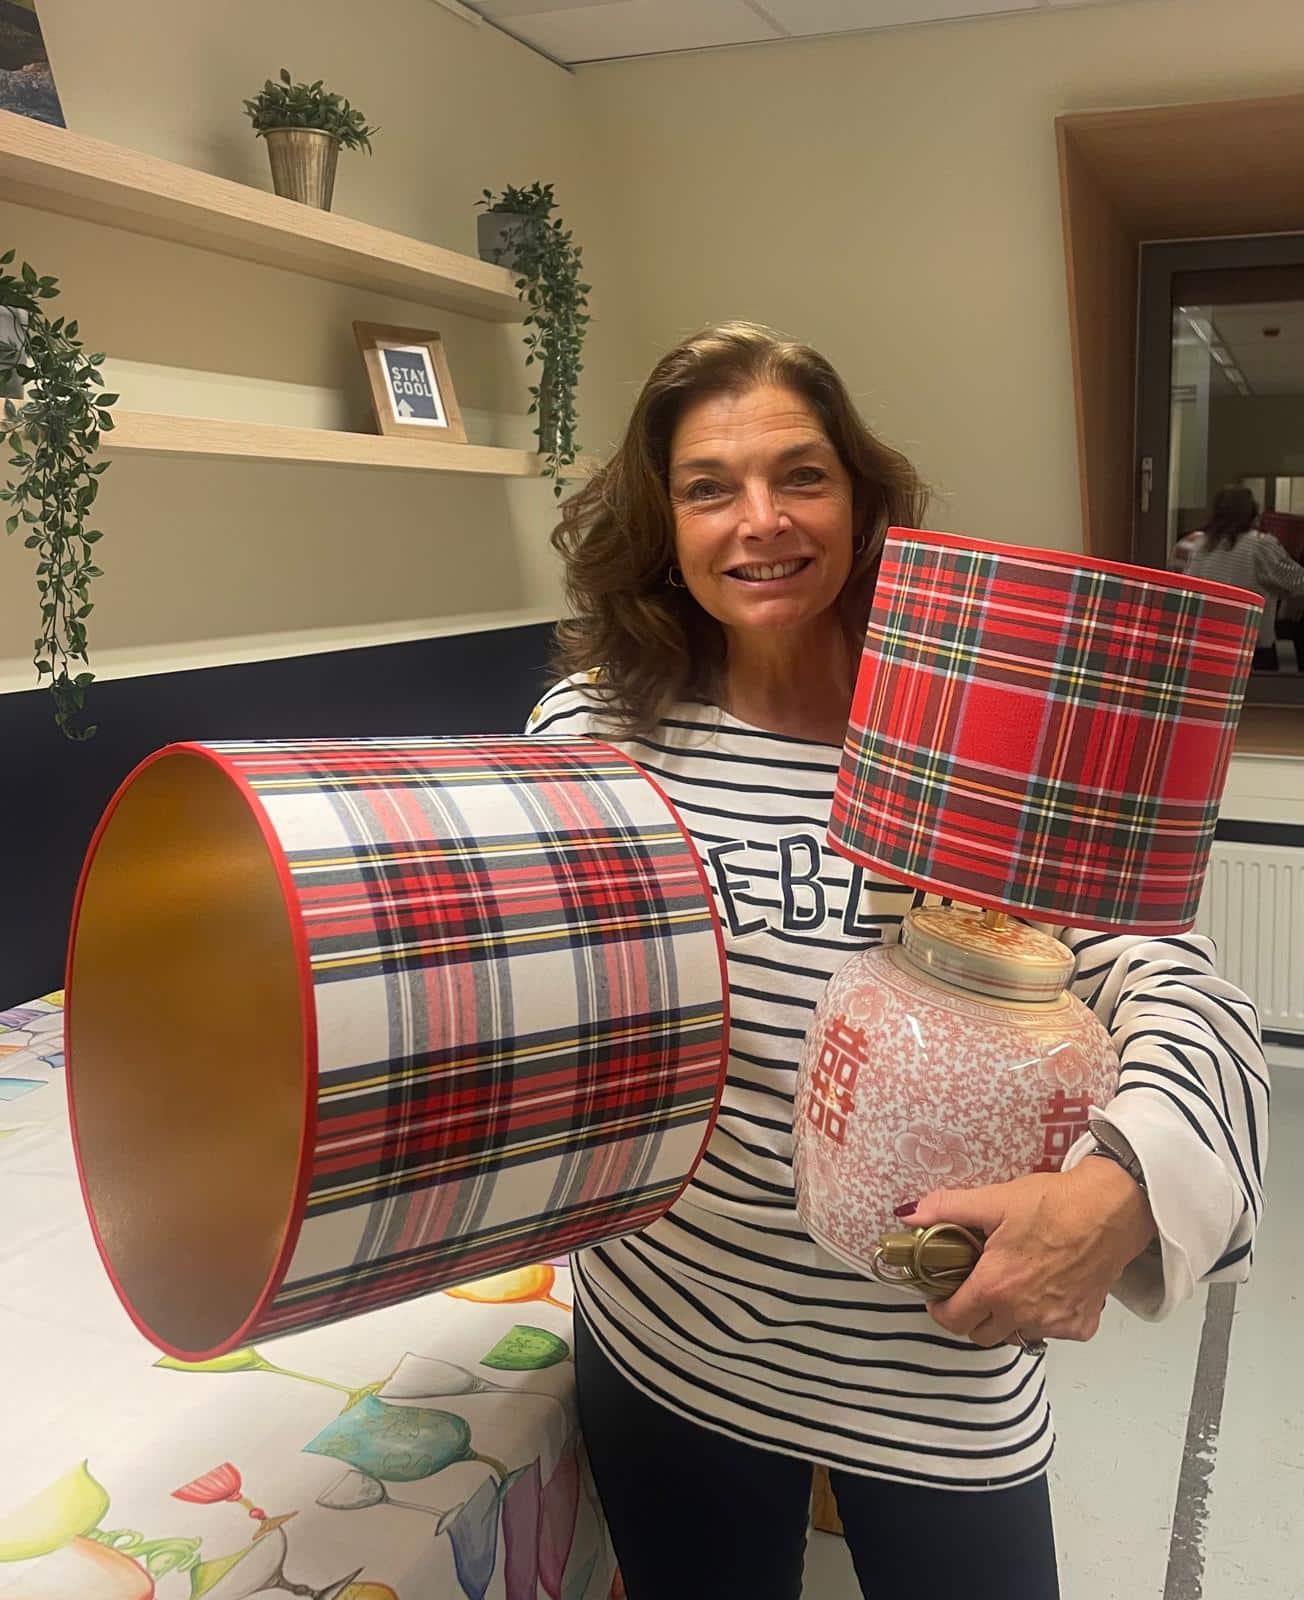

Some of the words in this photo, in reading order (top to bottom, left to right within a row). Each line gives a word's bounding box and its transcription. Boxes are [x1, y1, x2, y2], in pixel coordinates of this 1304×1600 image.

[391, 366, 425, 383] STAY
[393, 380, 433, 397] COOL
[707, 833, 926, 938] EBL
